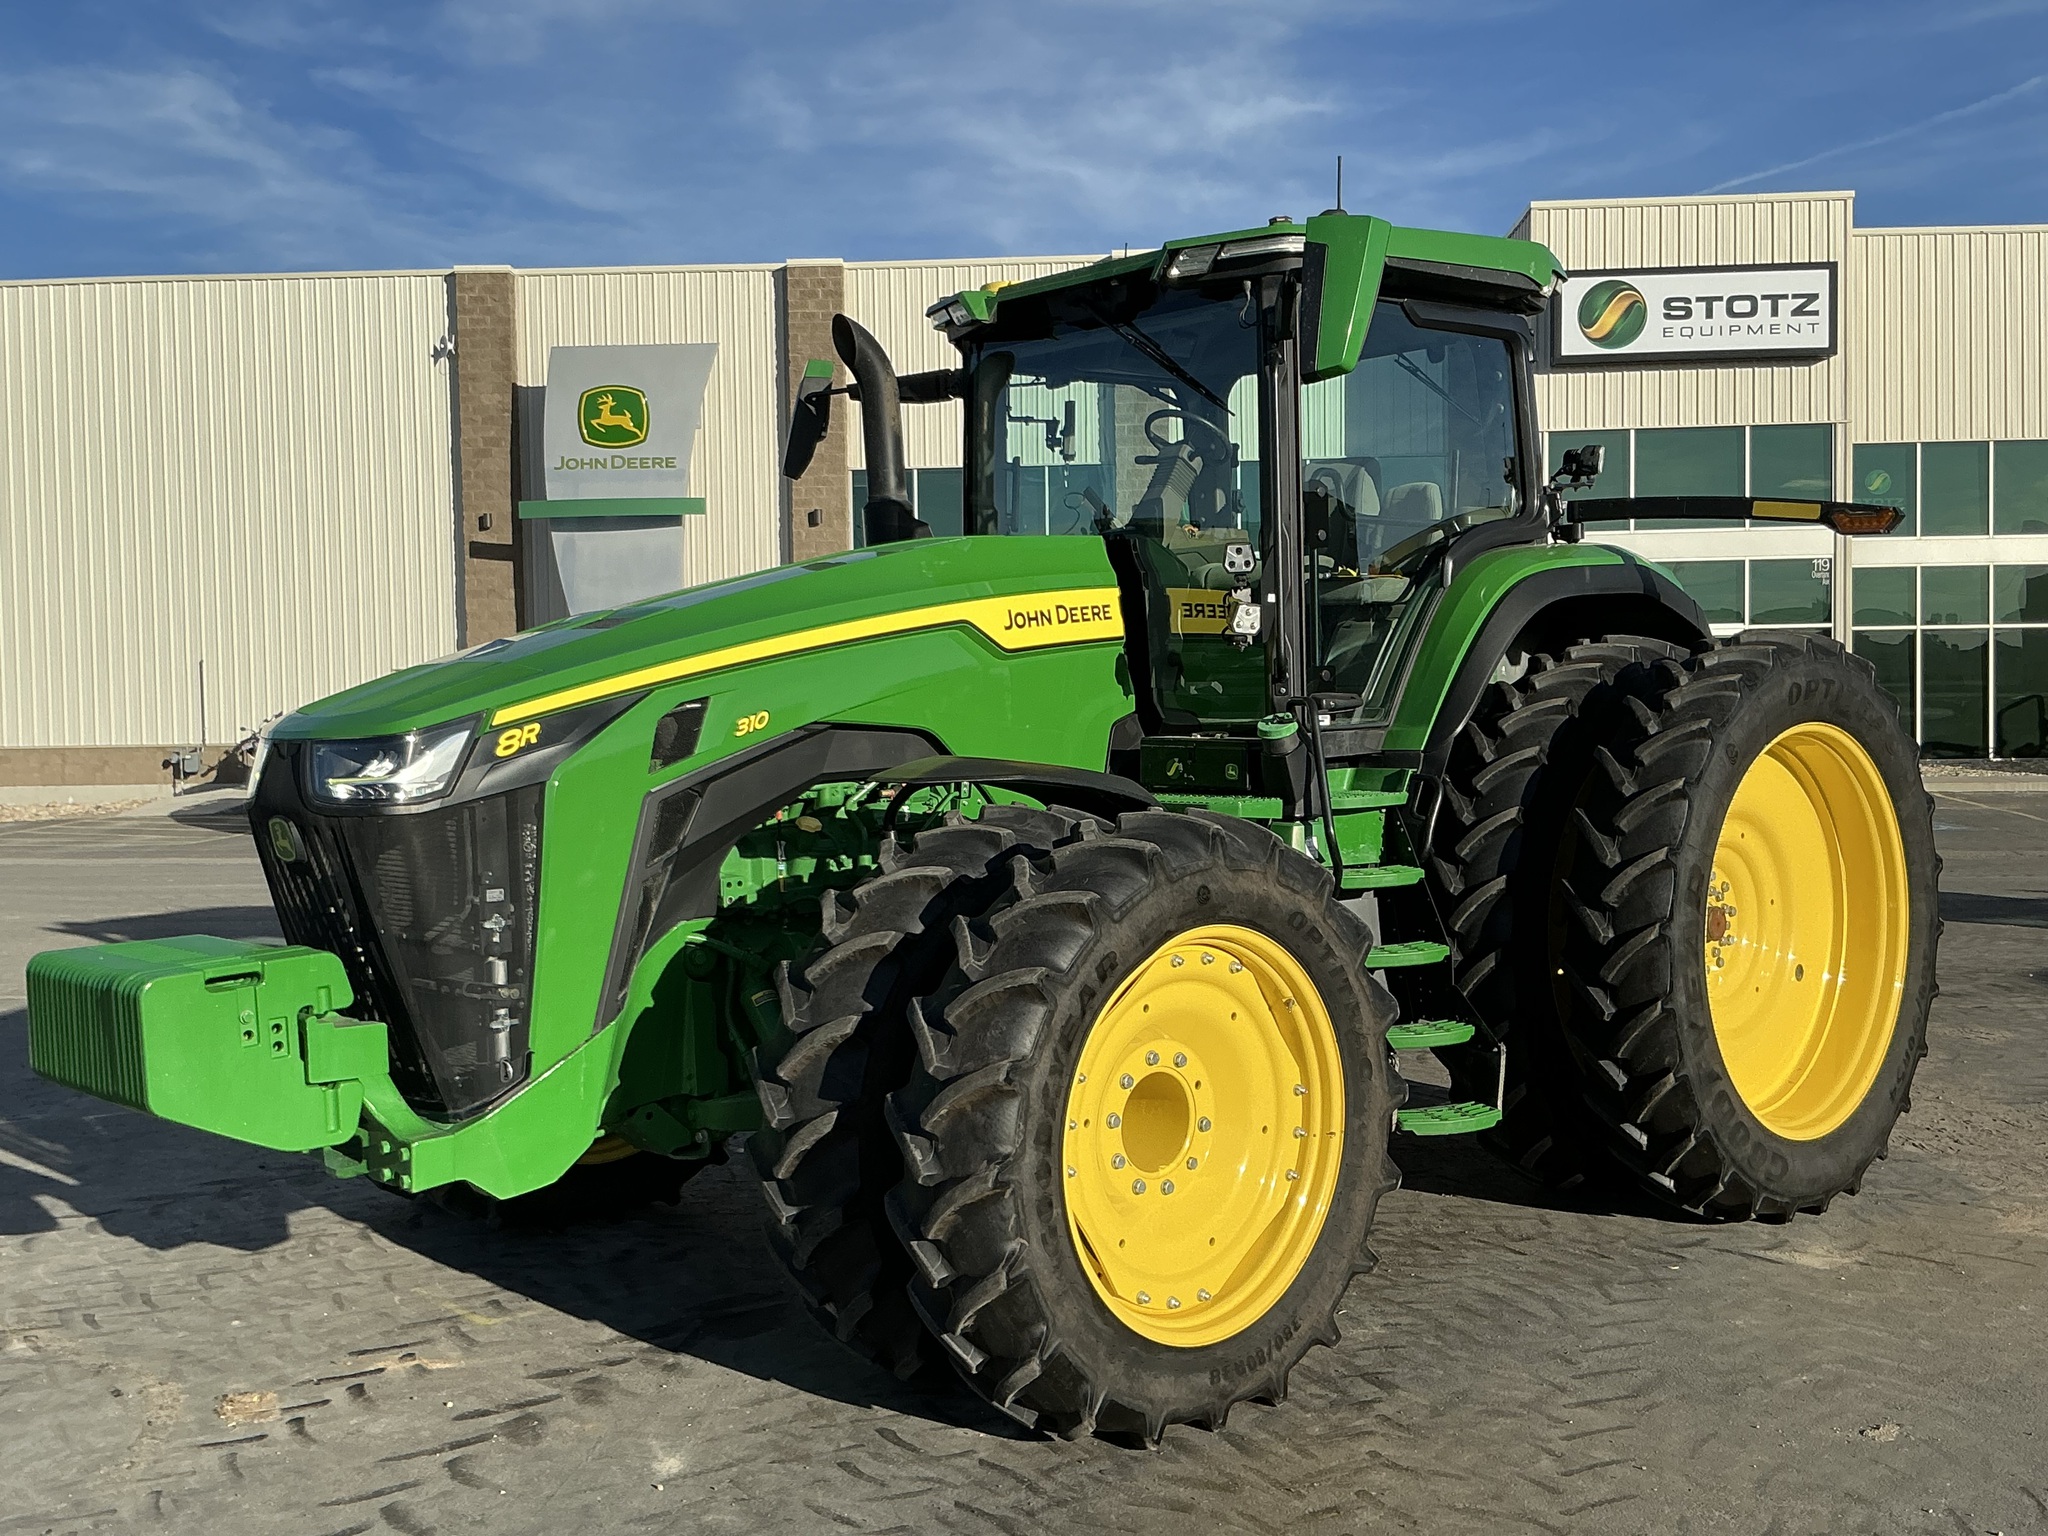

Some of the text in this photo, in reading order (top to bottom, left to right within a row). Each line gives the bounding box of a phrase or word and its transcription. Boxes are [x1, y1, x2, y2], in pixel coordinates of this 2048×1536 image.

[1662, 293, 1820, 321] STOTZ
[1662, 323, 1820, 339] EQUIPMENT
[554, 455, 677, 470] JOHN DEERE
[1812, 558, 1830, 571] 119
[1004, 604, 1113, 631] JOHN DEERE
[733, 710, 770, 737] 310
[495, 722, 542, 758] 8R
